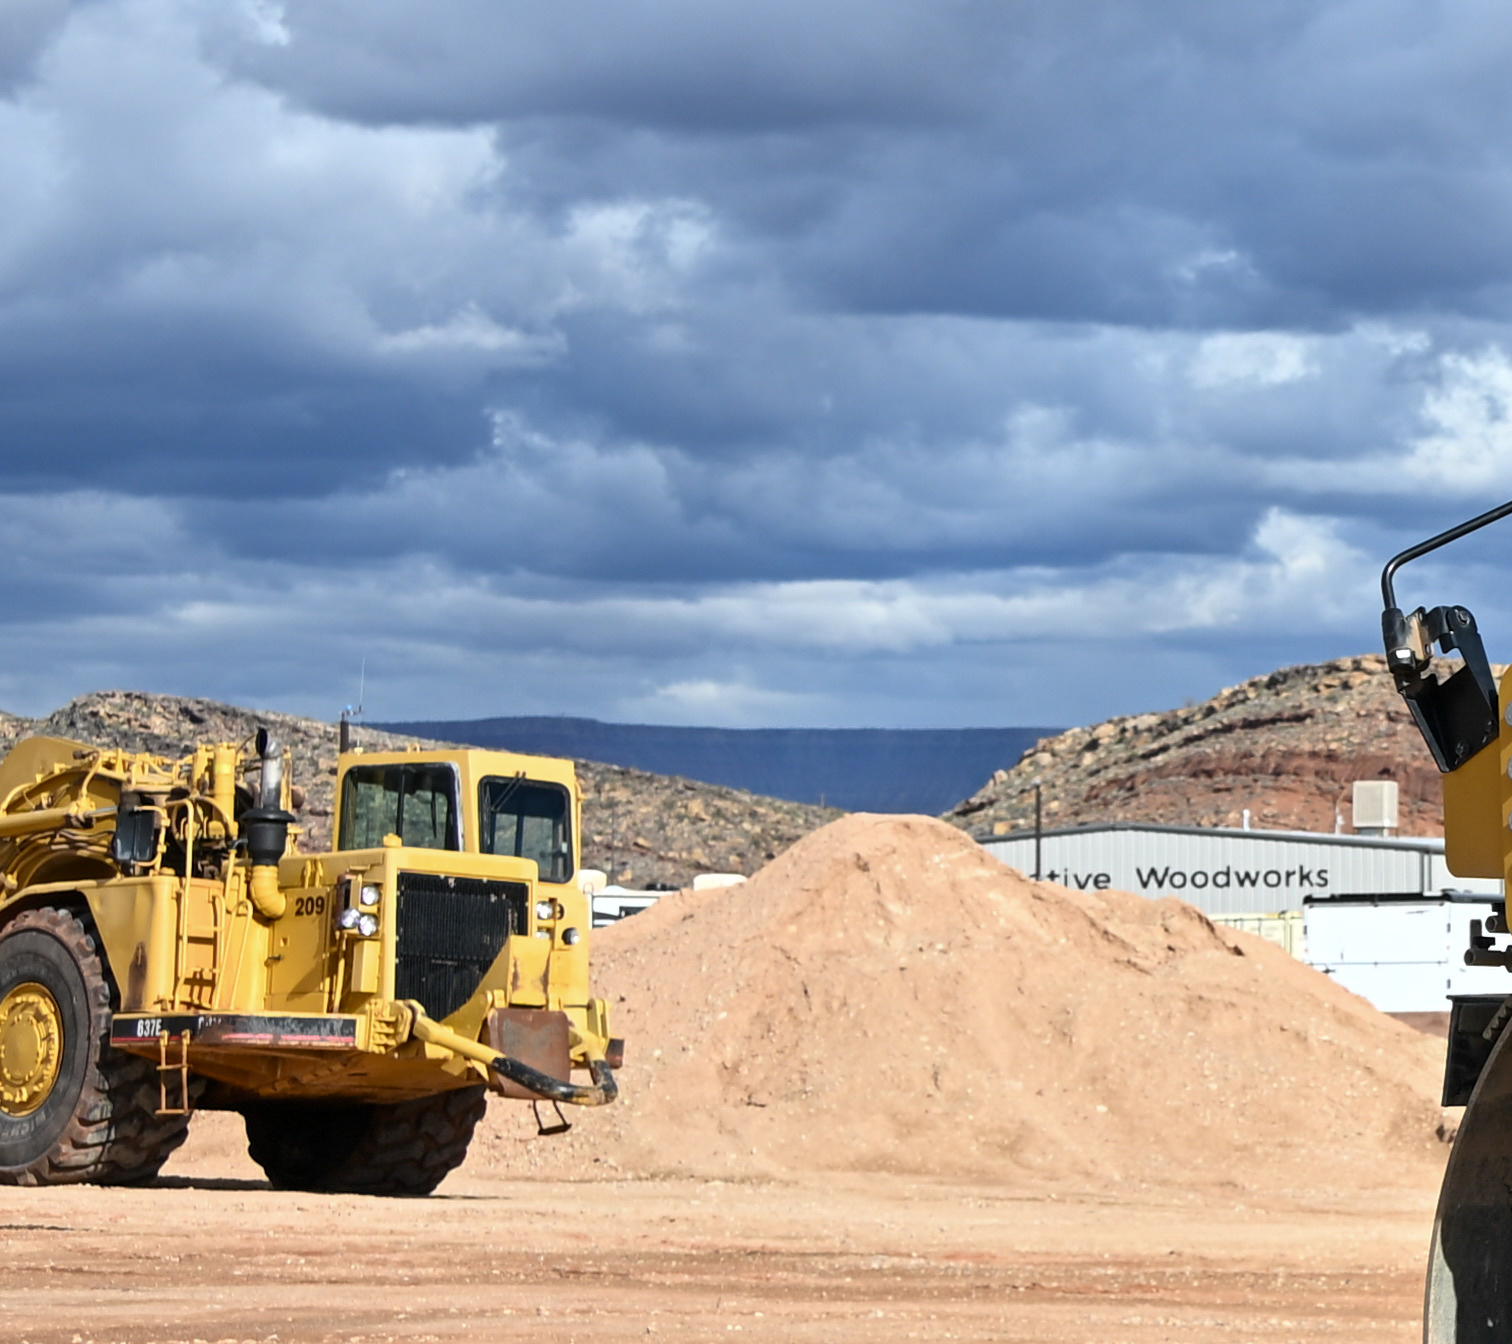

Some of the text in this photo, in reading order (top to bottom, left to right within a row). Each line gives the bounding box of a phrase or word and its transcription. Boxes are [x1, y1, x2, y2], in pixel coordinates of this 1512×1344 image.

[1136, 865, 1329, 889] Woodworks
[295, 895, 325, 916] 209
[137, 1018, 162, 1038] 637E
